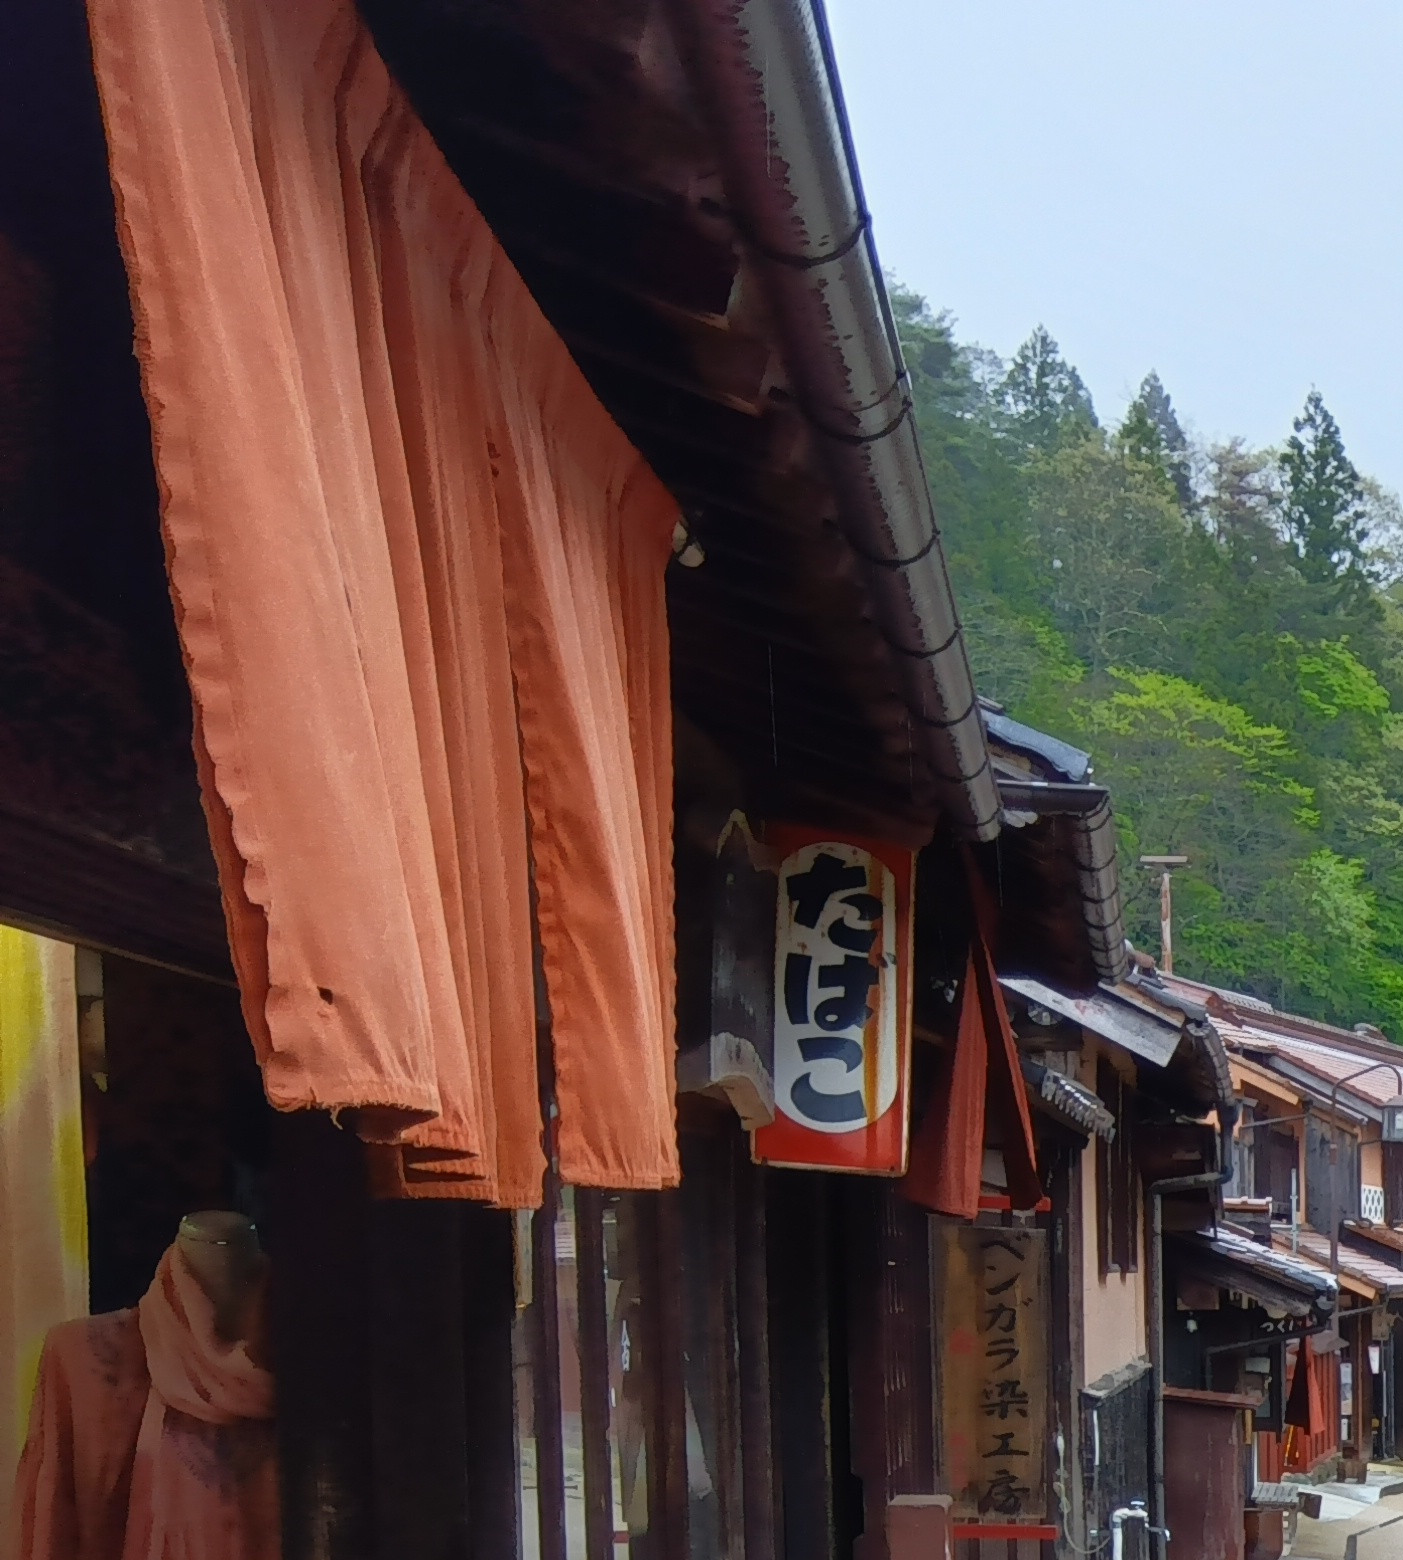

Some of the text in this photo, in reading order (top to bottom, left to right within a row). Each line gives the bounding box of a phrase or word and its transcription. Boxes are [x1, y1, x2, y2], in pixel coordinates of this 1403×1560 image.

[784, 853, 896, 1123] たばこ
[978, 1231, 1035, 1515] ベンガラ染工房
